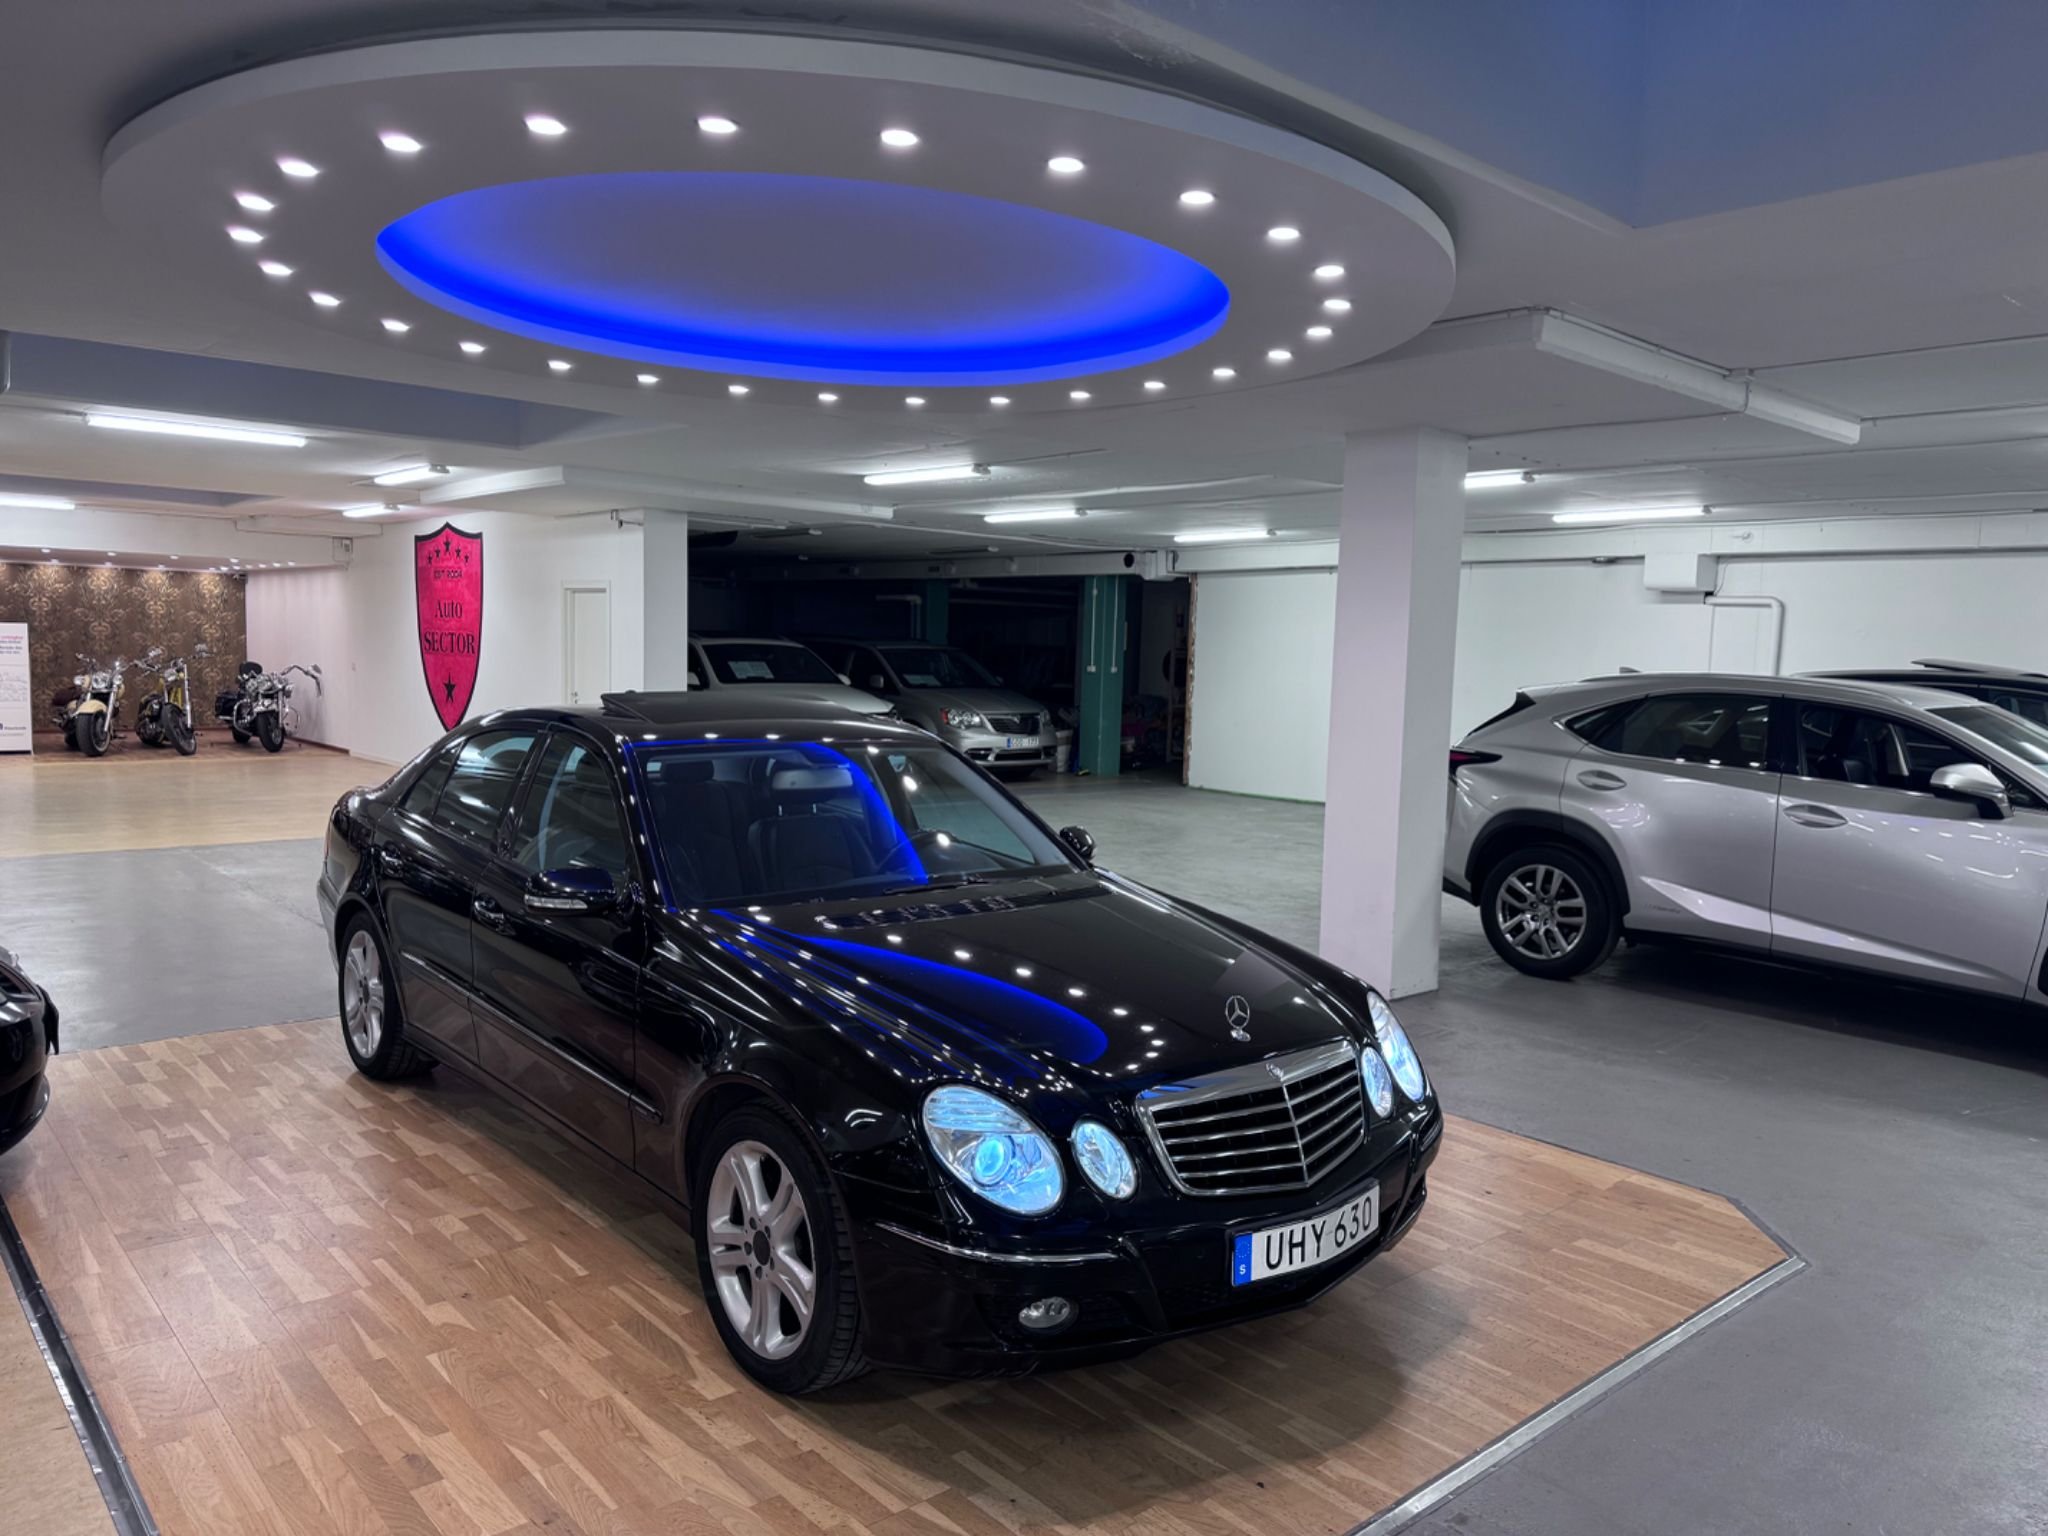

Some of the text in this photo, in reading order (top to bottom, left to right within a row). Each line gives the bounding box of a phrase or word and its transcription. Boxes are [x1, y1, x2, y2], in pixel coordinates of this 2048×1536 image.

[424, 631, 475, 654] SECTOR
[1266, 1196, 1372, 1270] UHY 630
[1239, 1264, 1246, 1275] S
